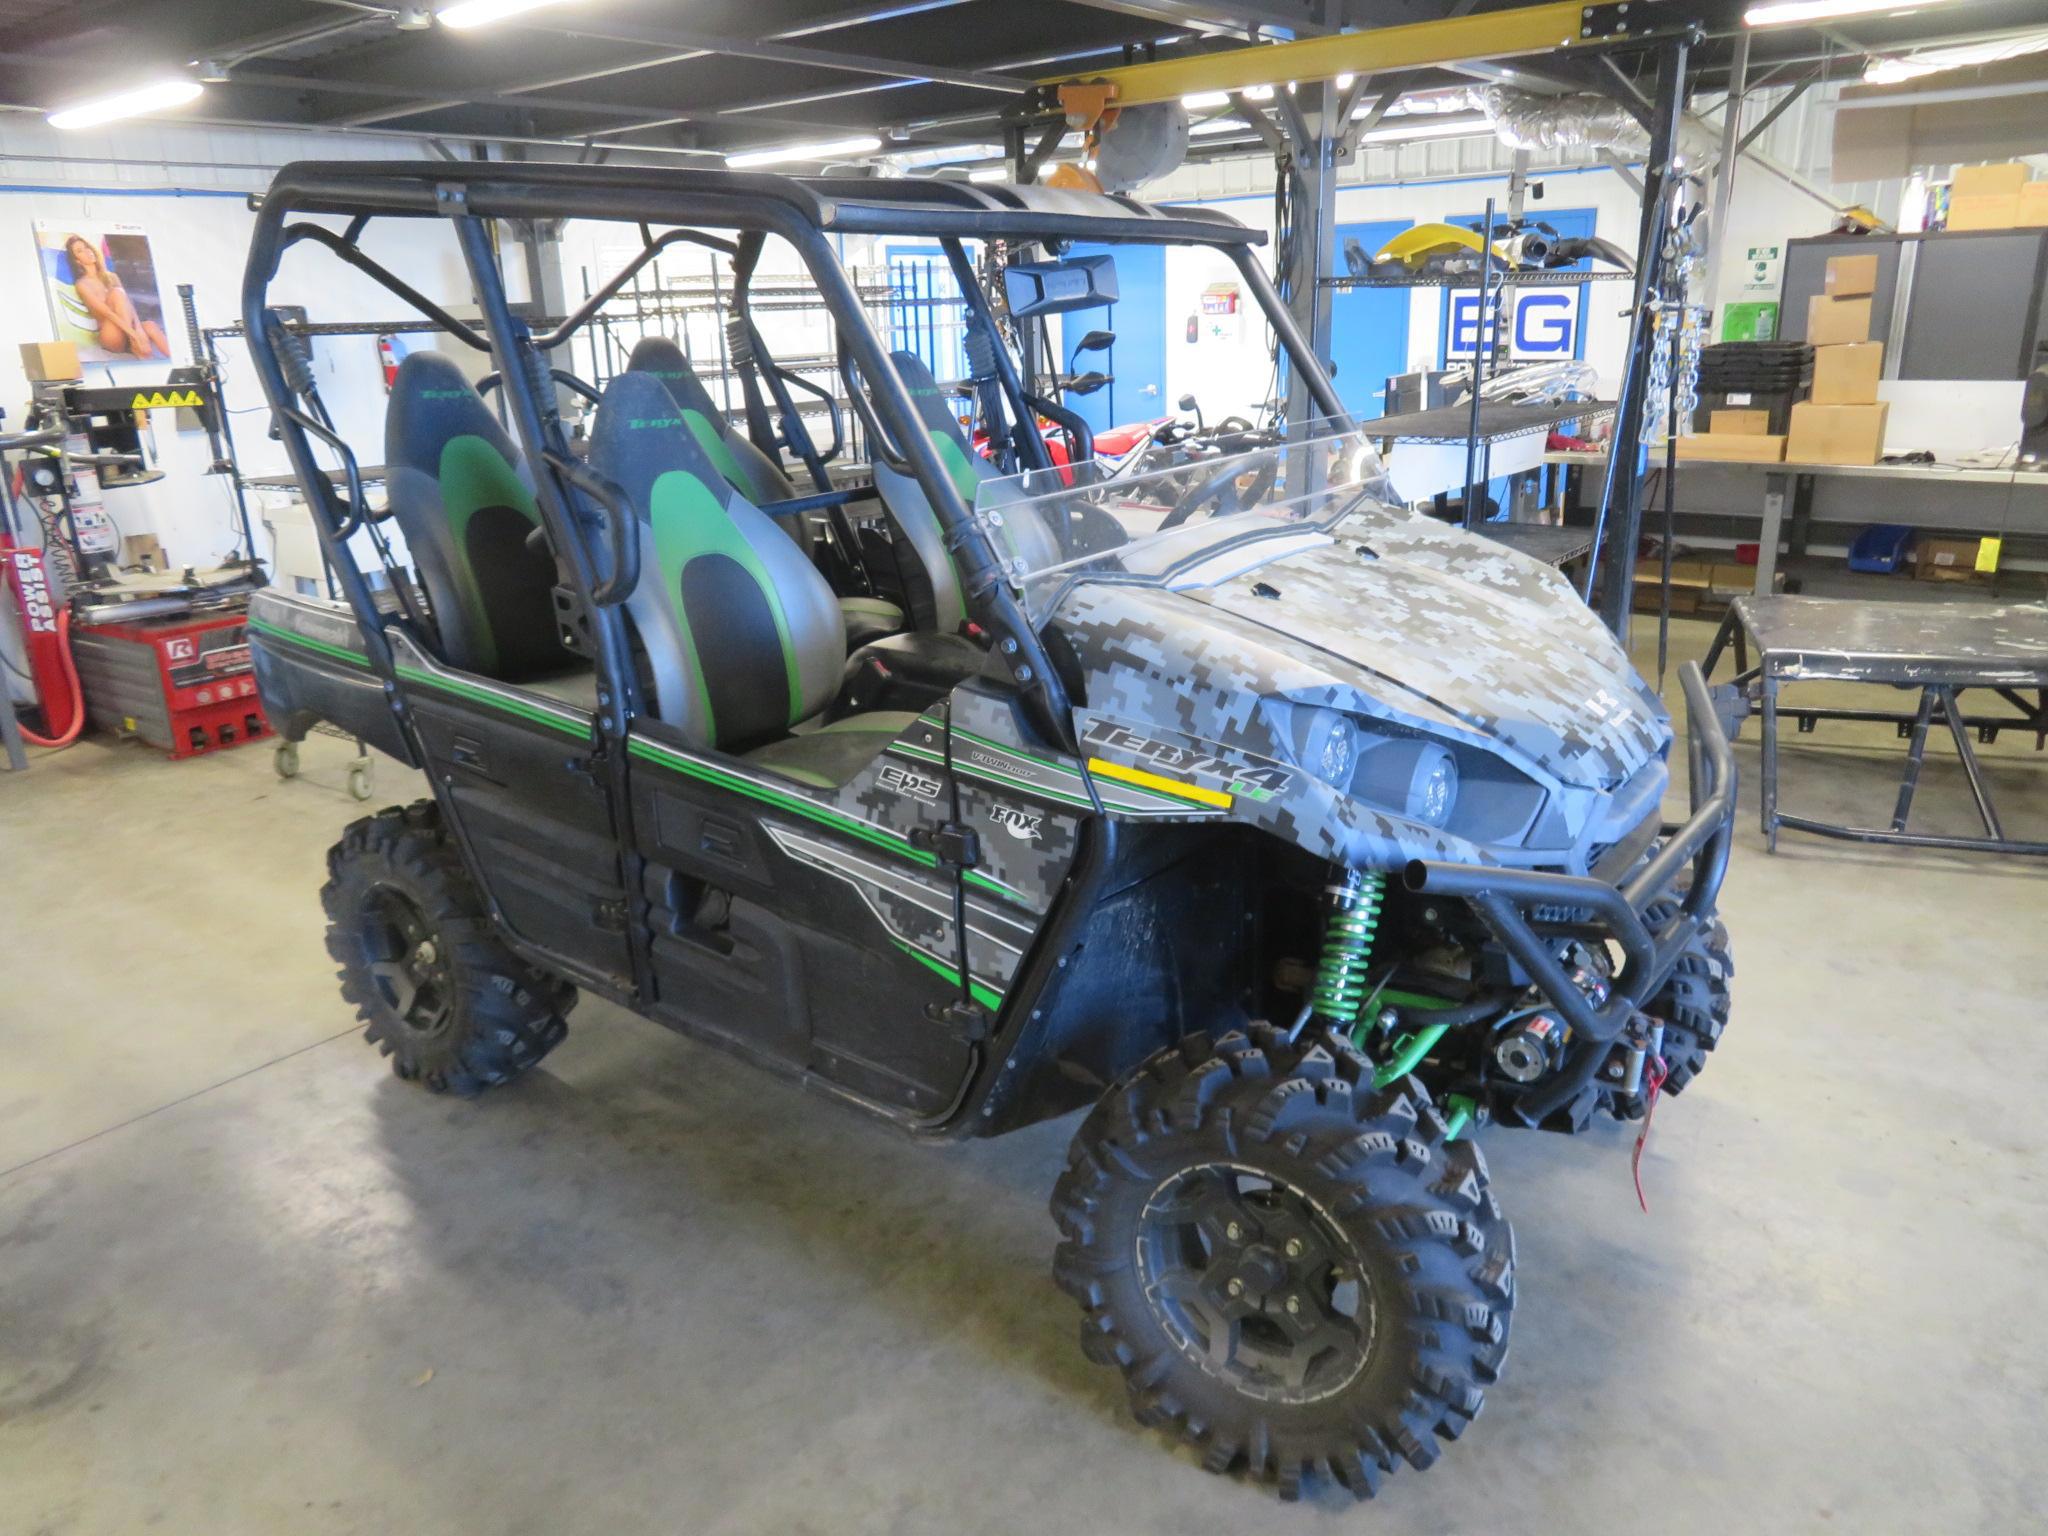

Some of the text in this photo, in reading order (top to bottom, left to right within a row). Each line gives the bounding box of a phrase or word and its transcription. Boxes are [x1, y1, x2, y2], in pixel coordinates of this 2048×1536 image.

[14, 553, 46, 632] POWER
[28, 553, 58, 633] ASSIST
[879, 764, 942, 798] EPS
[989, 804, 1042, 834] FOX
